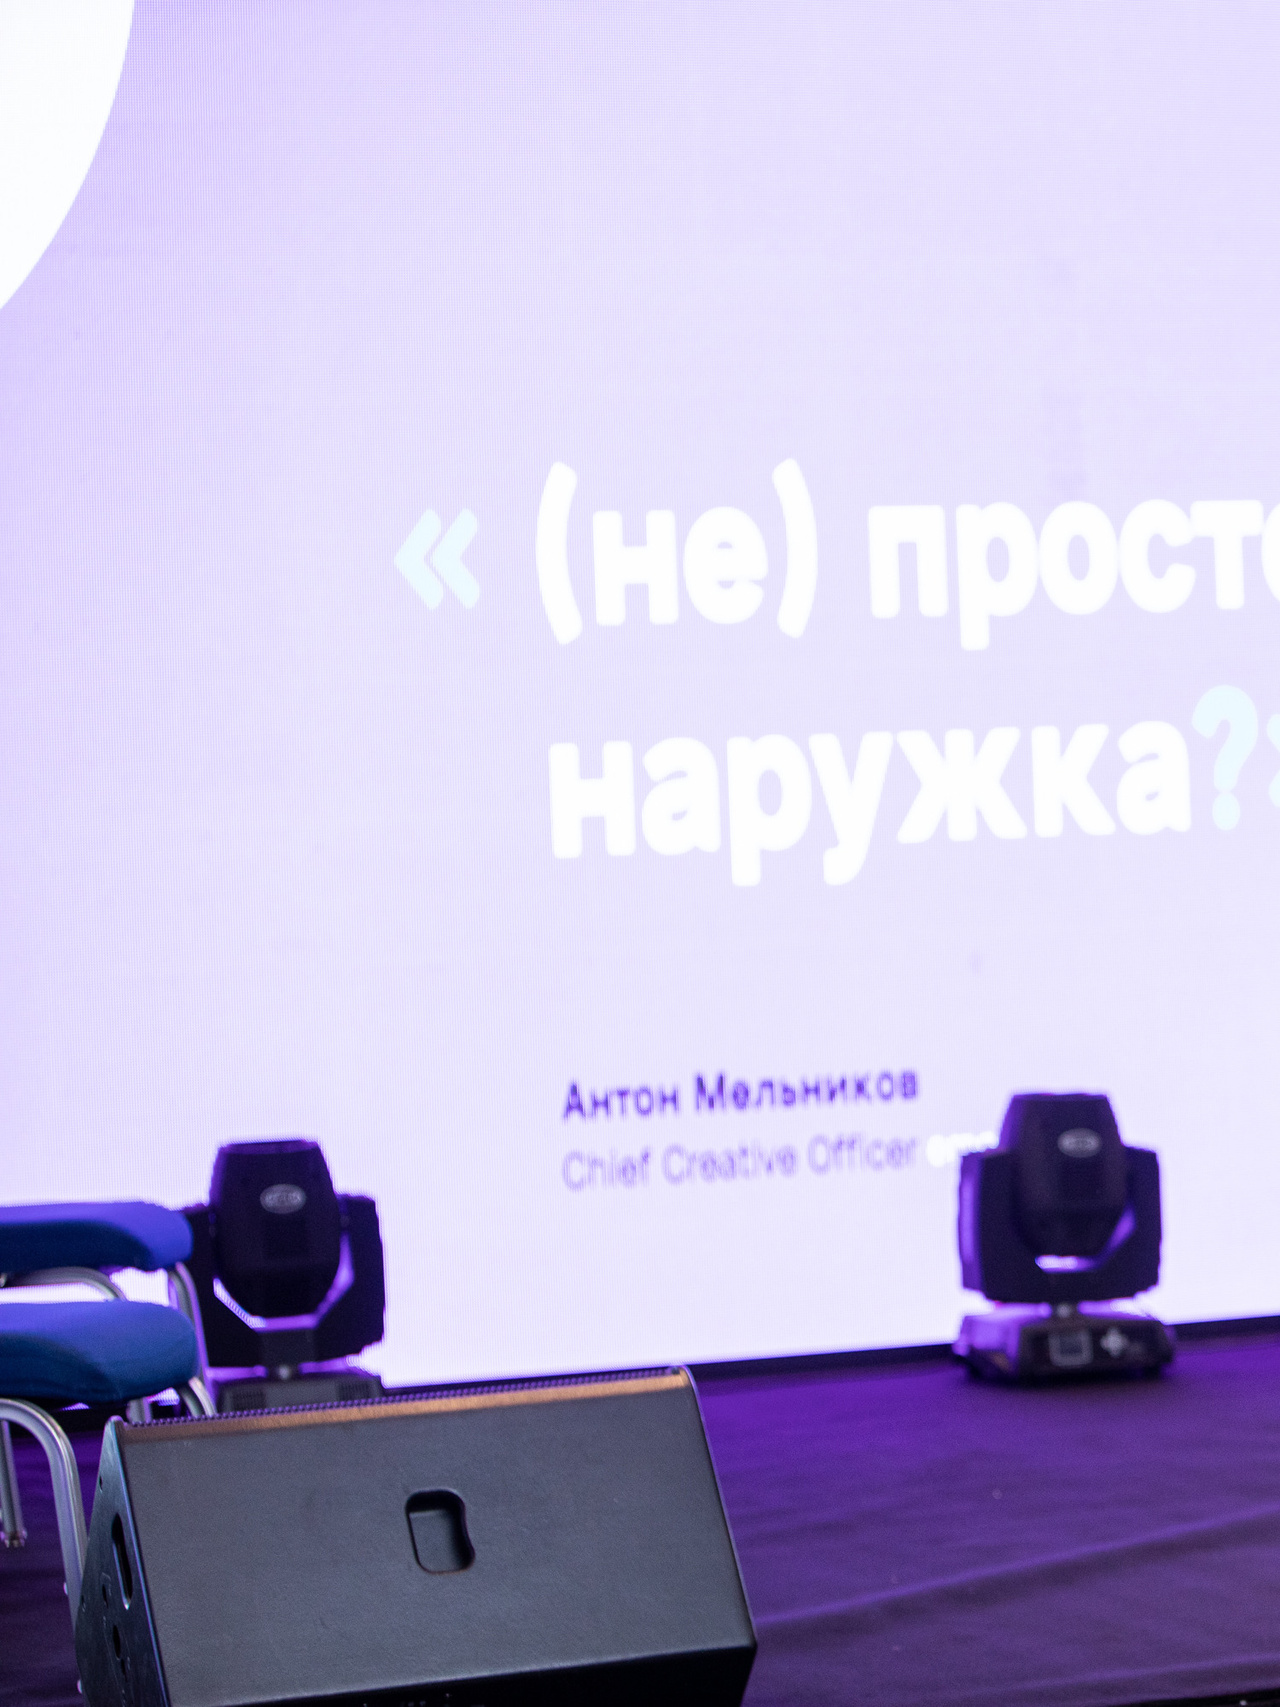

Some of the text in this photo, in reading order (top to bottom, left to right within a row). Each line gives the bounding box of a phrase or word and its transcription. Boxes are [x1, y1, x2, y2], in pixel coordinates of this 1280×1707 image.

[535, 458, 819, 645] (не)
[563, 1070, 919, 1121] Антон Мельников
[562, 1148, 652, 1191] Chief
[663, 1144, 798, 1185] Creative
[807, 1132, 918, 1176] Officer
